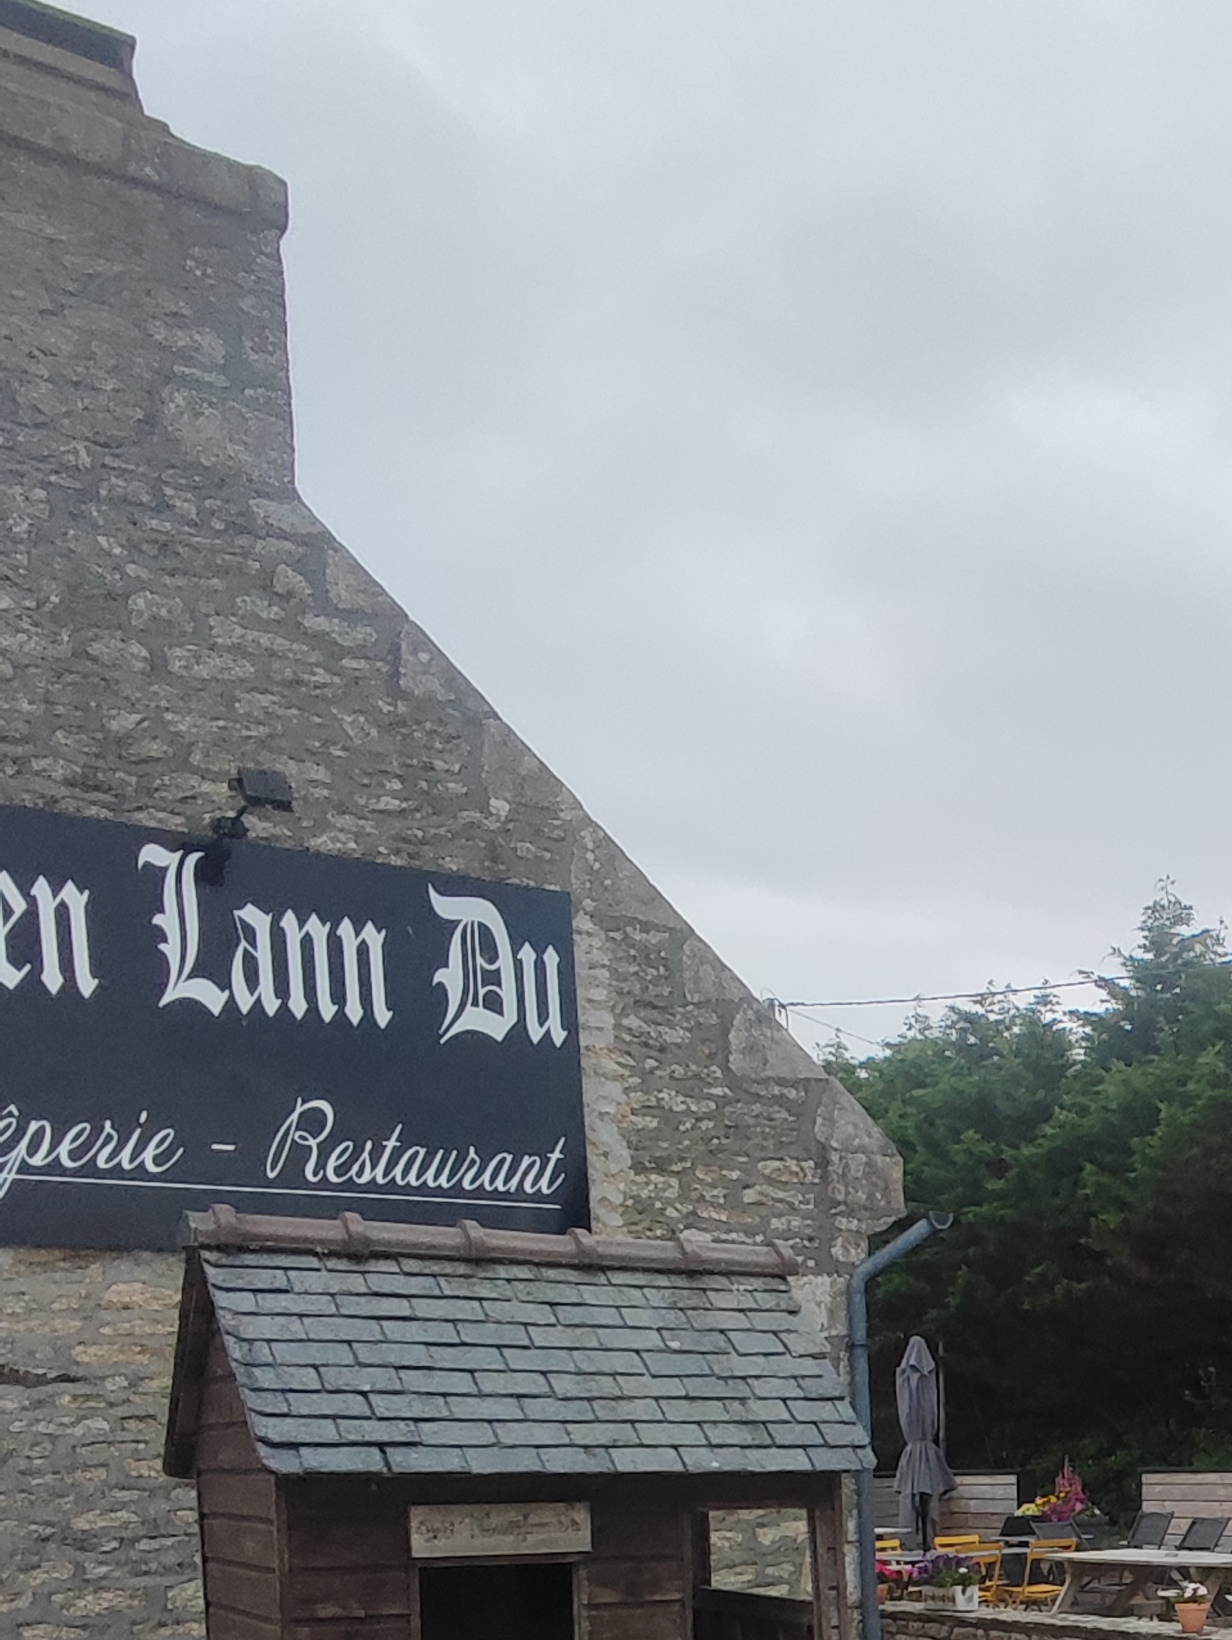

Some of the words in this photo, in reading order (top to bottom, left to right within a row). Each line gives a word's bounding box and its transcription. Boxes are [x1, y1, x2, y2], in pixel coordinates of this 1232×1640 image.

[137, 842, 393, 1030] Lann
[427, 882, 569, 1048] Du
[265, 1096, 567, 1195] Restaurant
